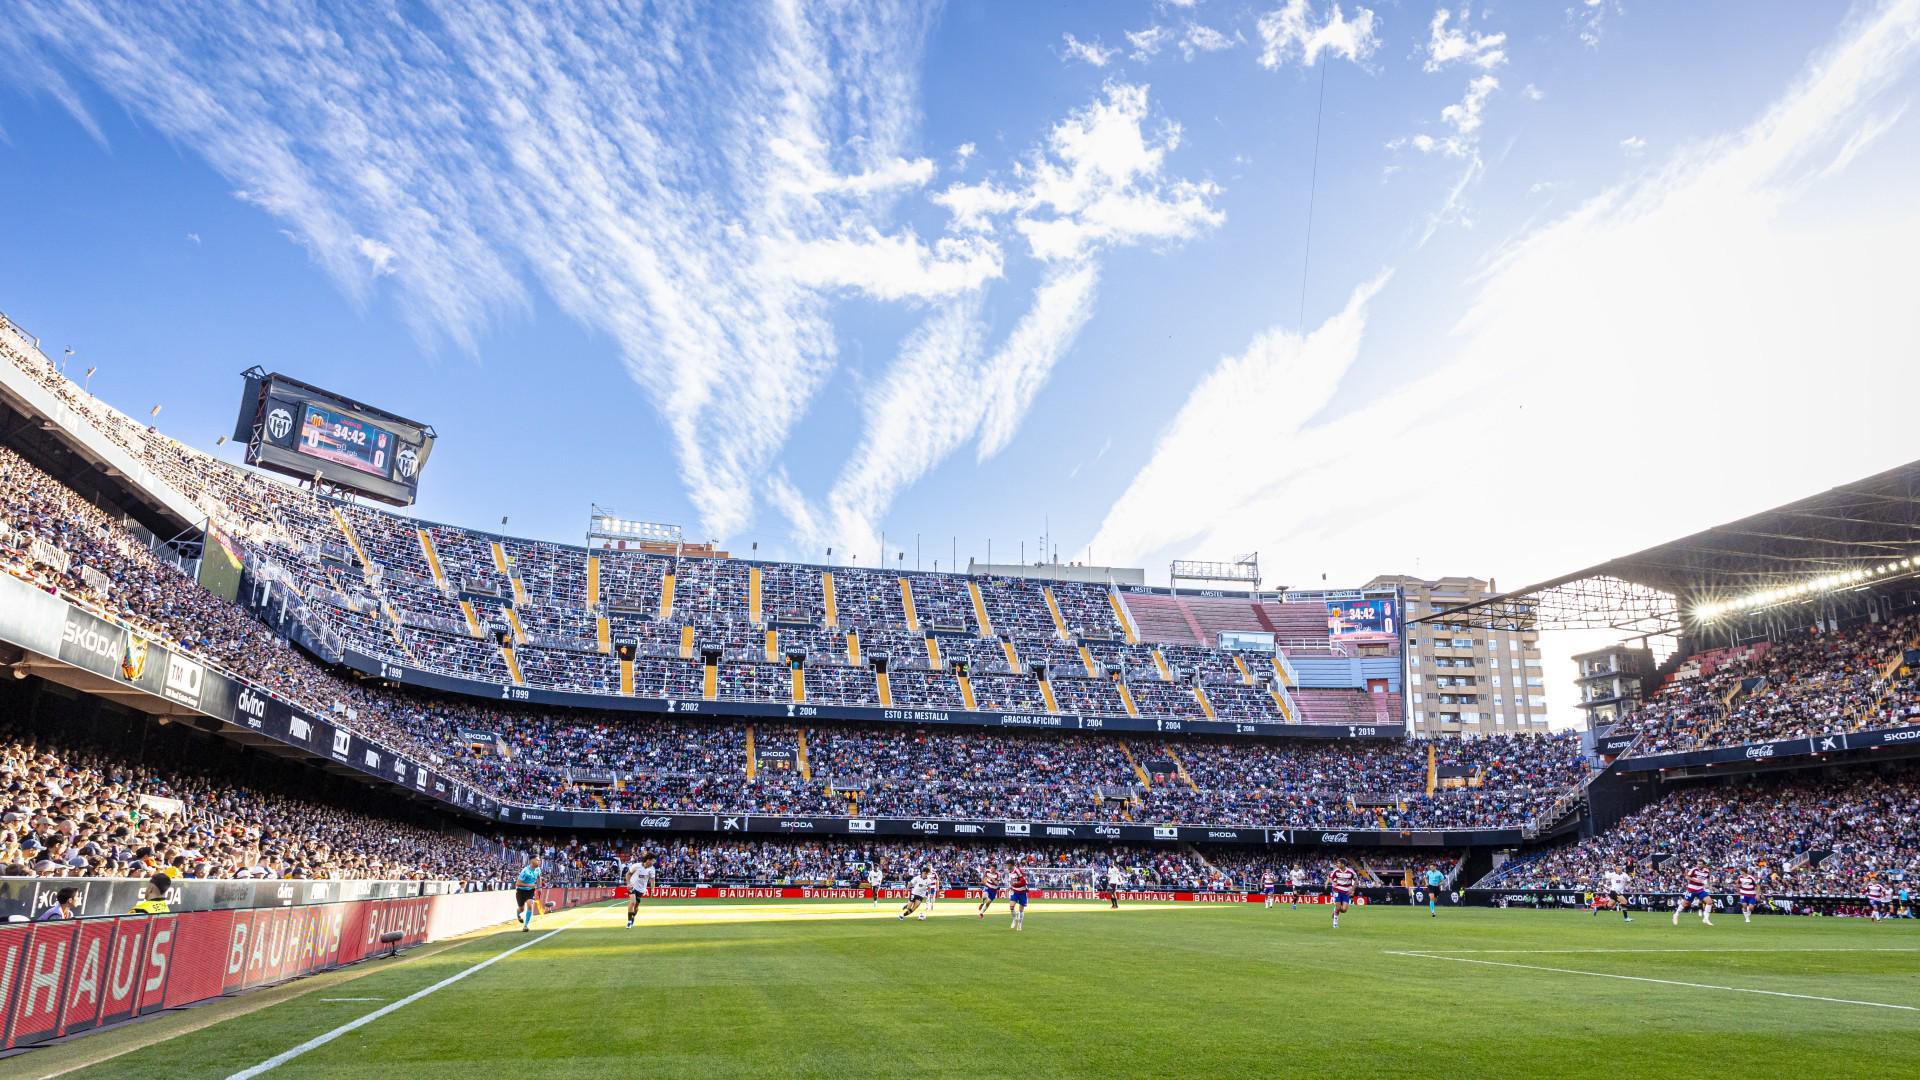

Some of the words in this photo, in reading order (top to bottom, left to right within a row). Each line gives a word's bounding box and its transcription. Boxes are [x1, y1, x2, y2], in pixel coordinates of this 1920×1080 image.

[307, 430, 320, 448] 0
[333, 423, 366, 446] 34:42
[374, 450, 385, 468] 0
[1349, 607, 1375, 620] 34:42
[1384, 617, 1393, 634] 0
[615, 638, 638, 646] AMSTEL
[388, 666, 402, 679] 1999
[511, 689, 529, 699] 1999
[238, 688, 265, 718] divina
[680, 702, 699, 712] 2002
[799, 707, 817, 716] 2004
[884, 710, 902, 719] ESTO
[904, 711, 913, 720] ES
[914, 711, 949, 721] MESTALLA
[1001, 715, 1032, 725] ¡GRACIAS
[1032, 716, 1062, 726] AFICIÓN!
[1086, 718, 1103, 727] 2004
[1165, 721, 1181, 730] 2004
[1358, 727, 1375, 736] 2019
[1607, 740, 1631, 749] Acronis
[912, 820, 939, 830] divina
[954, 825, 977, 833] PUMA
[1095, 825, 1121, 834] divina
[1046, 827, 1068, 835] PUMA
[643, 889, 697, 897] AUHAUS
[719, 889, 783, 898] BAUHAUS
[804, 890, 866, 898] BAUHAUS
[1120, 893, 1175, 901] BAUHAUS
[1193, 894, 1248, 903] BAUHAUS
[366, 903, 429, 945] BAUHAUS
[228, 912, 342, 974] BAUHAUS
